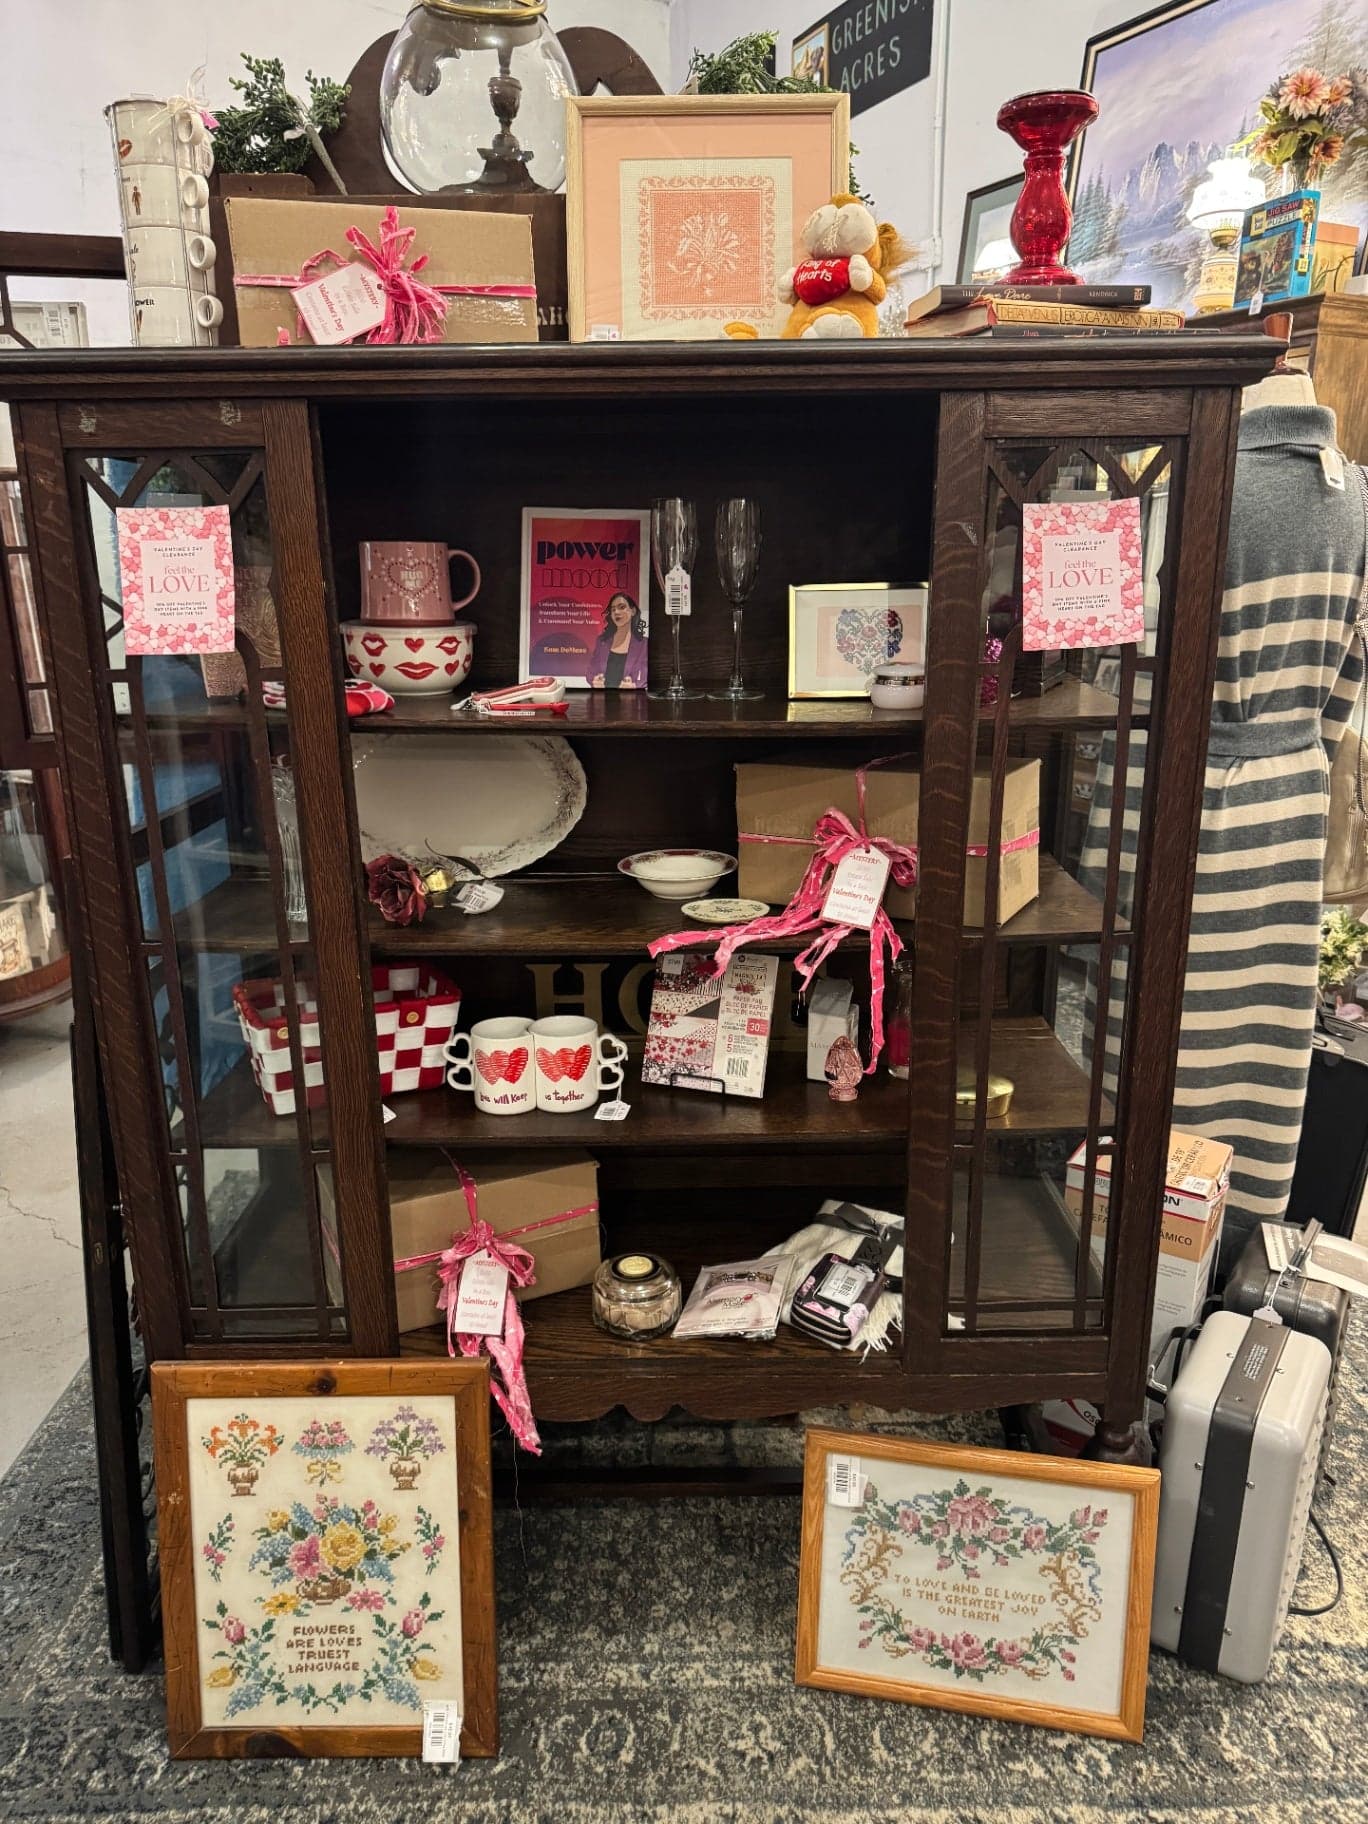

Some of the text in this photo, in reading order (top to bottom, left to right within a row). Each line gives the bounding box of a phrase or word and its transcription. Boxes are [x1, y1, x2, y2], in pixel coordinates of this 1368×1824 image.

[840, 36, 901, 93] ACRES
[1267, 200, 1300, 217] JIG SAW
[796, 268, 833, 285] Hearts
[333, 317, 345, 332] Day
[537, 541, 635, 565] power
[164, 565, 196, 576] feel the
[1064, 559, 1097, 570] feel the
[542, 563, 629, 589] mood
[1049, 567, 1114, 589] LOVE
[149, 575, 211, 594] LOVE
[863, 894, 875, 905] Day
[750, 1022, 761, 1032] 30
[552, 1090, 585, 1105] together
[488, 1299, 499, 1309] Day
[894, 1574, 911, 1585] TO
[915, 1578, 948, 1590] LOVE
[952, 1583, 979, 1595] AND
[1004, 1589, 1047, 1606] LOVED
[902, 1588, 1040, 1617] IS THE GREATEST JOY
[937, 1606, 1000, 1623] ON EARTH
[293, 1625, 355, 1636] FLOWERS
[286, 1637, 362, 1648] ARE LOVES
[298, 1649, 350, 1660] TRUEST
[288, 1661, 360, 1673] LANGUAGE
